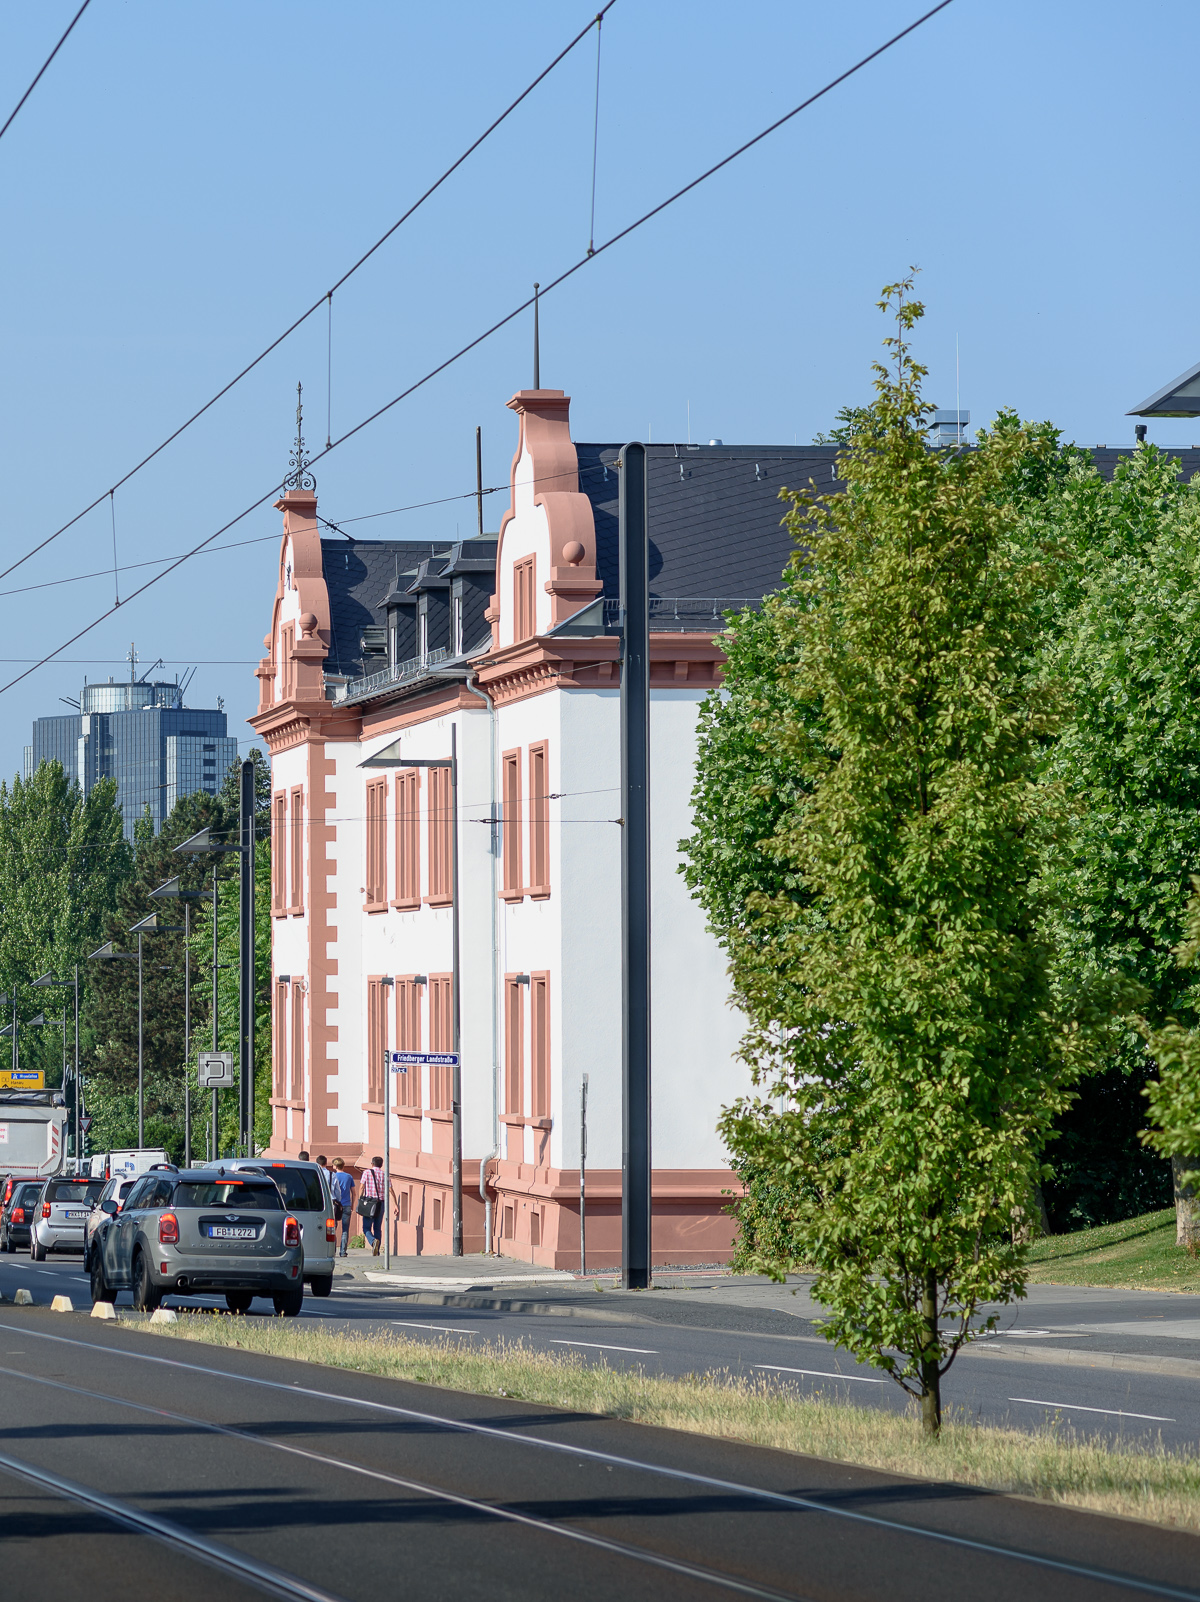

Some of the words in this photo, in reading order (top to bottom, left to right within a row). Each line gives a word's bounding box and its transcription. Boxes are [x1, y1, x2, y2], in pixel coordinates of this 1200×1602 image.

[397, 1054, 425, 1063] Friedberger
[427, 1055, 453, 1063] Landstraße
[216, 1228, 227, 1236] FB
[237, 1228, 252, 1237] 272
